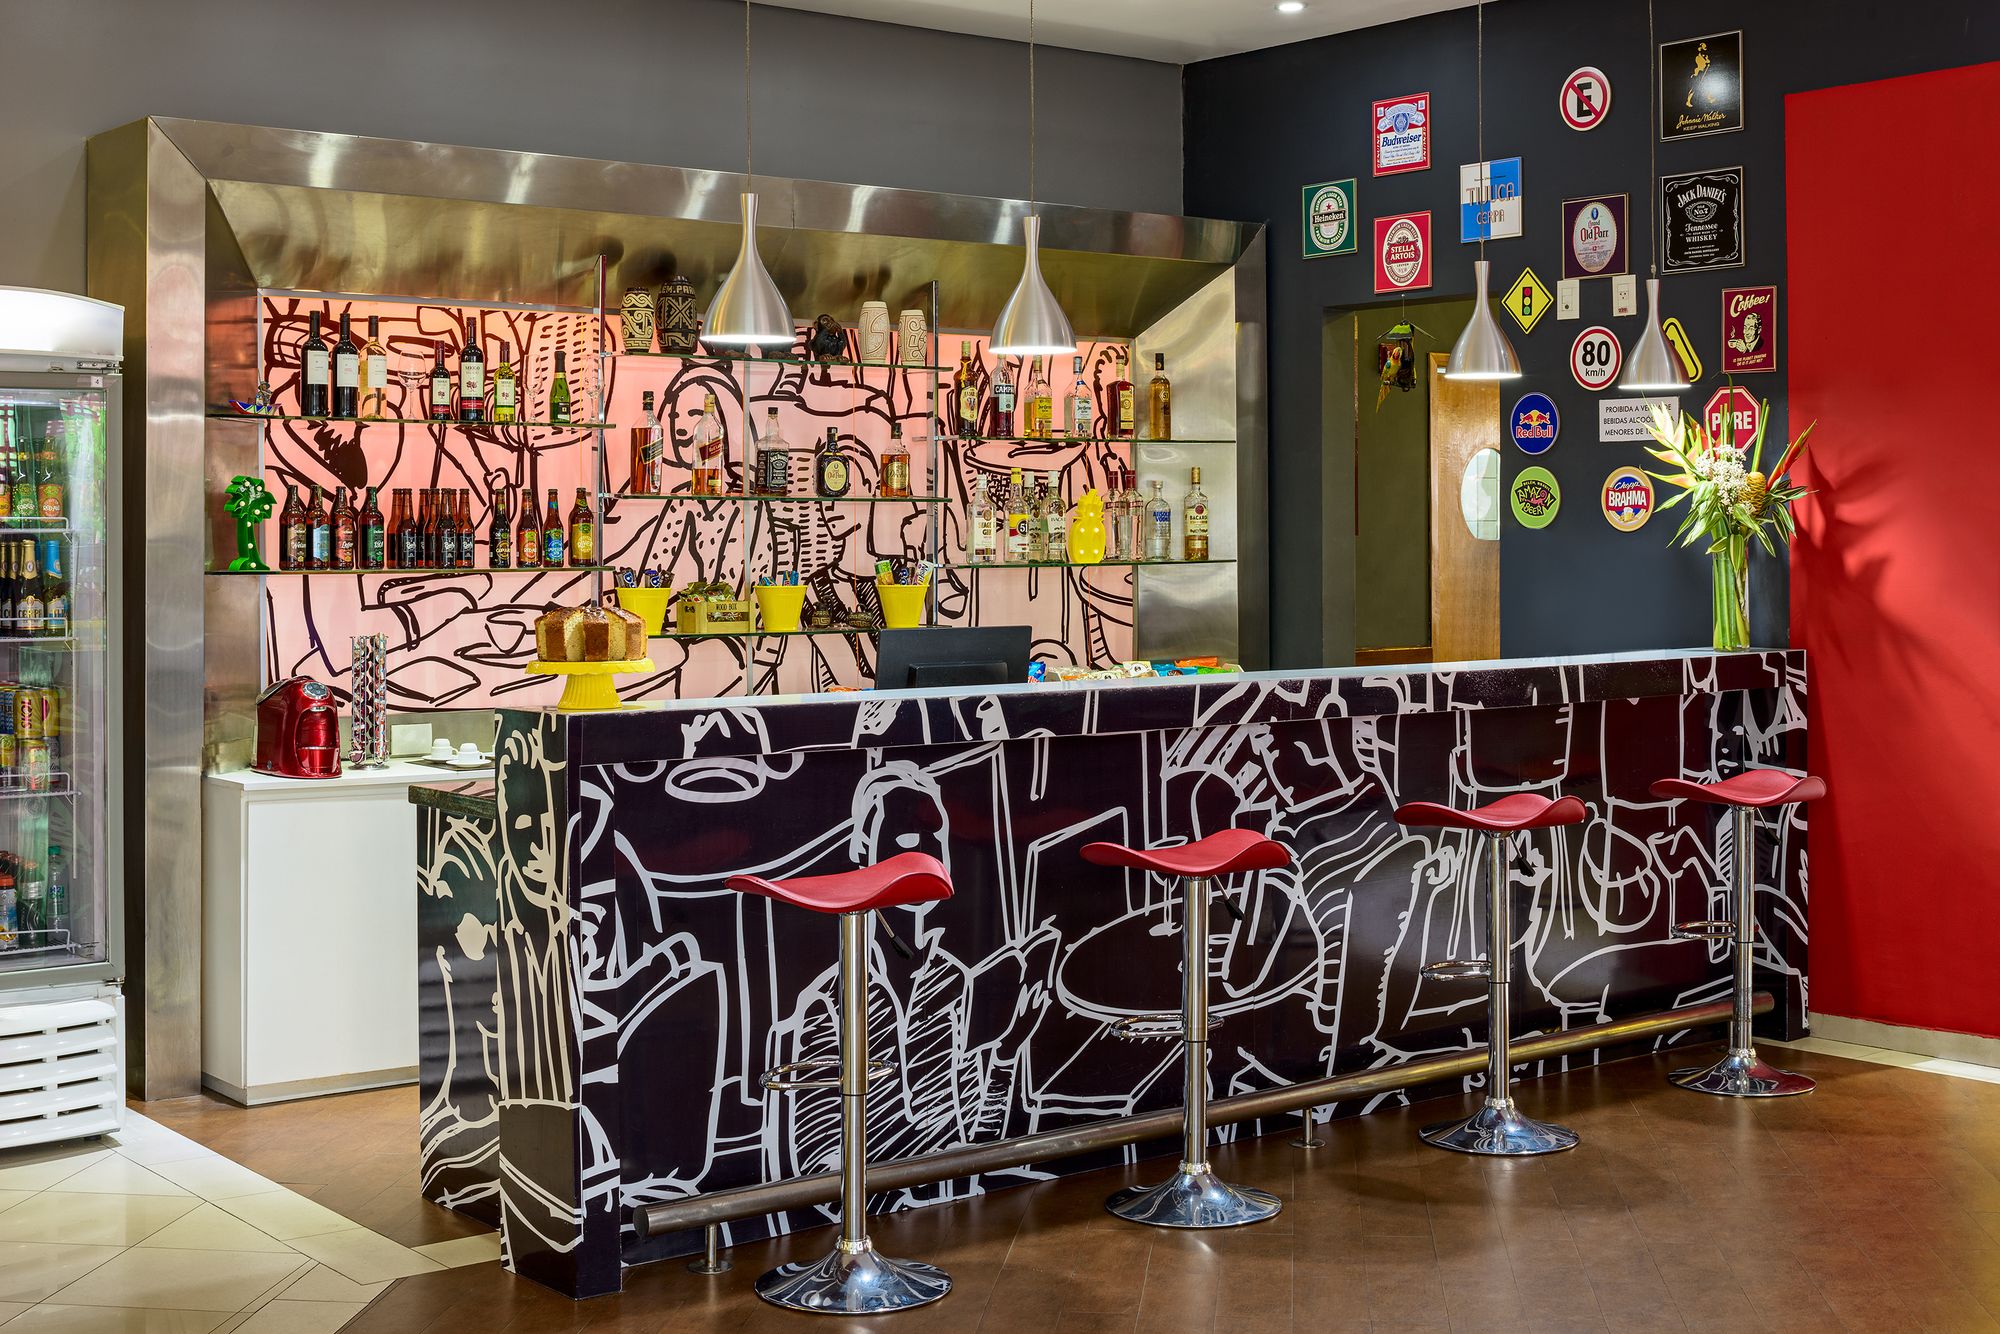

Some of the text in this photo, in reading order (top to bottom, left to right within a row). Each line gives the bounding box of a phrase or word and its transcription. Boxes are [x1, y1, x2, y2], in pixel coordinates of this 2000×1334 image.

[1381, 133, 1422, 147] Budweiser
[1466, 182, 1514, 206] TIJUCA
[1677, 184, 1727, 208] JACK DANIEL'S
[1314, 211, 1345, 223] Heineken
[1476, 209, 1505, 225] CERPA
[1580, 226, 1609, 242] Old Parr
[1684, 222, 1718, 233] Tennessee
[1685, 233, 1718, 243] WHISKEY
[1391, 244, 1415, 254] STELLA
[1390, 252, 1415, 261] ARTOIS
[1730, 294, 1770, 318] Coffee!
[1582, 340, 1610, 366] 80
[1585, 368, 1605, 377] km/h
[1605, 405, 1633, 413] PROIBIDA
[1516, 425, 1553, 438] Red Bull
[1605, 428, 1634, 436] MENORES
[1517, 485, 1555, 507] AMAZON
[1608, 490, 1647, 507] BRAHMA
[1523, 504, 1542, 515] BEER
